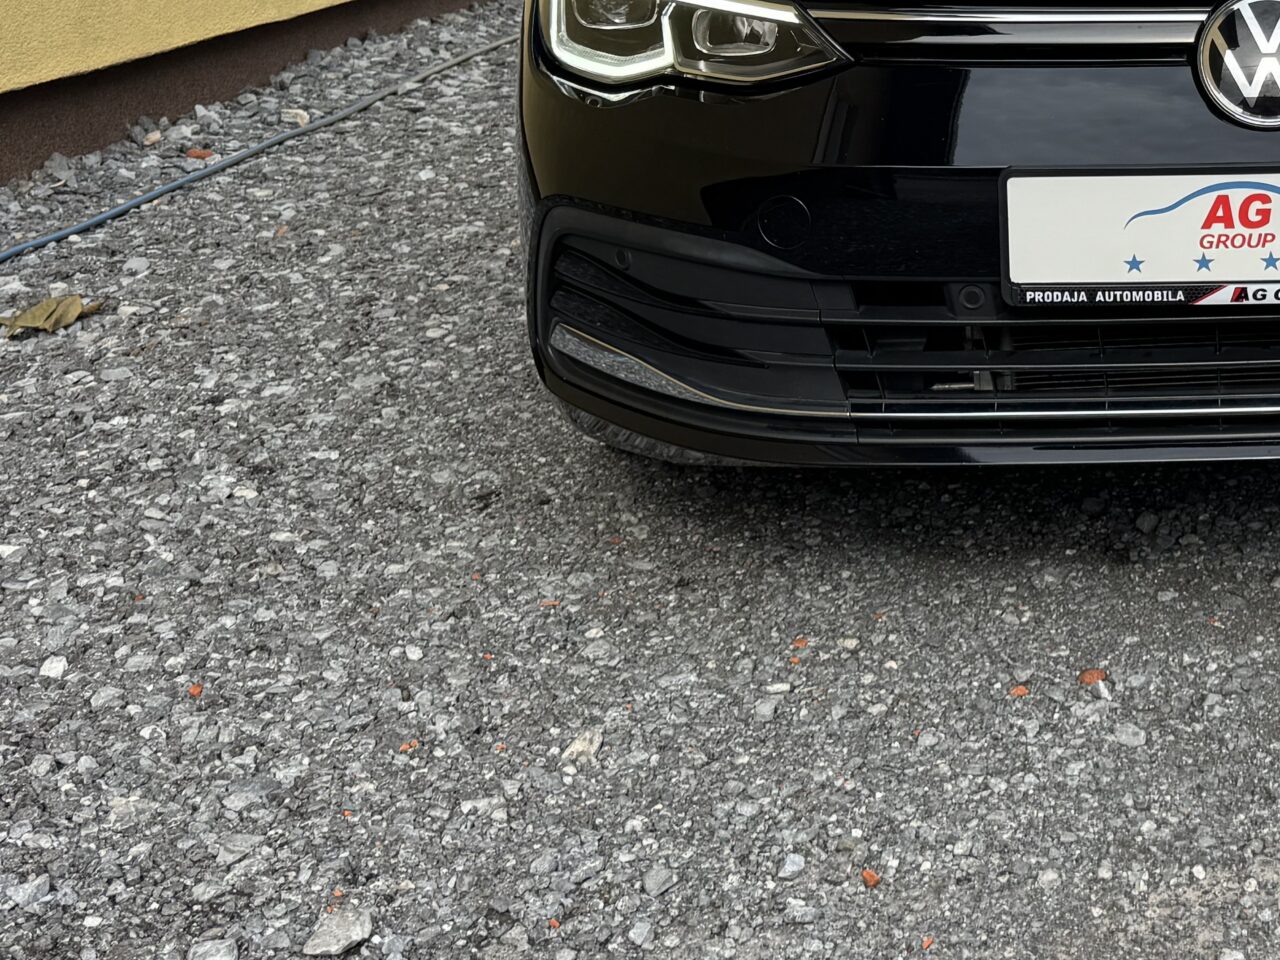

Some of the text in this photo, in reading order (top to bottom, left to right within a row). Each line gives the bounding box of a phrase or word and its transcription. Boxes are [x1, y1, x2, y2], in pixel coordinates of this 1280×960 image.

[1200, 193, 1273, 230] AG
[1199, 233, 1276, 249] GROUP
[1026, 289, 1185, 303] PRODAJA AUTOMOBILA
[1230, 286, 1268, 303] AG
